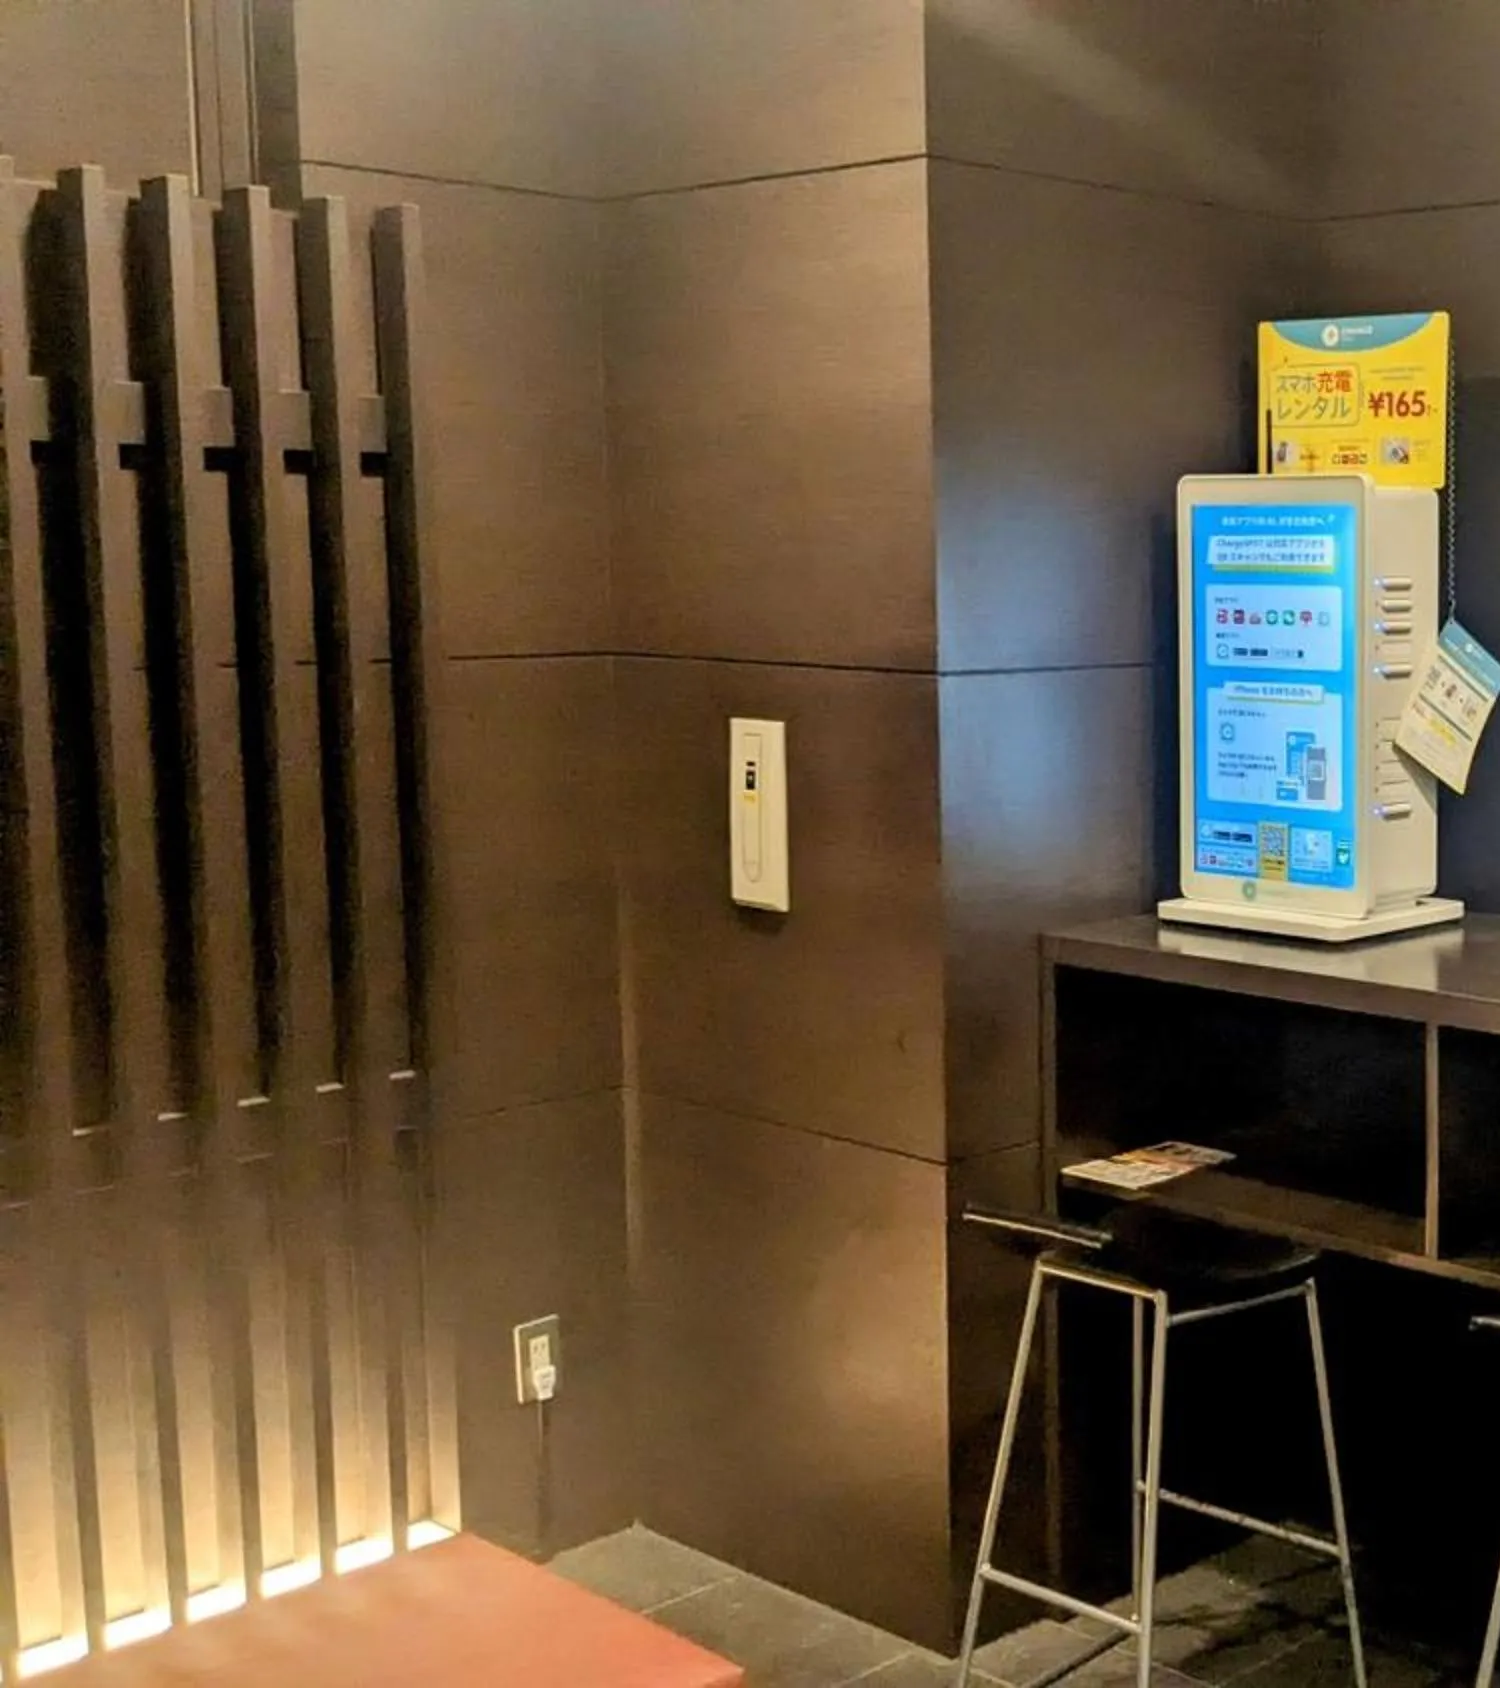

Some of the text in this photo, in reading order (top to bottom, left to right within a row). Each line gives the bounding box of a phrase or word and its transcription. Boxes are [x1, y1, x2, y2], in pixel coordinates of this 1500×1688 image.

[1276, 368, 1352, 394] スマホ充電
[1276, 395, 1352, 420] レンタル
